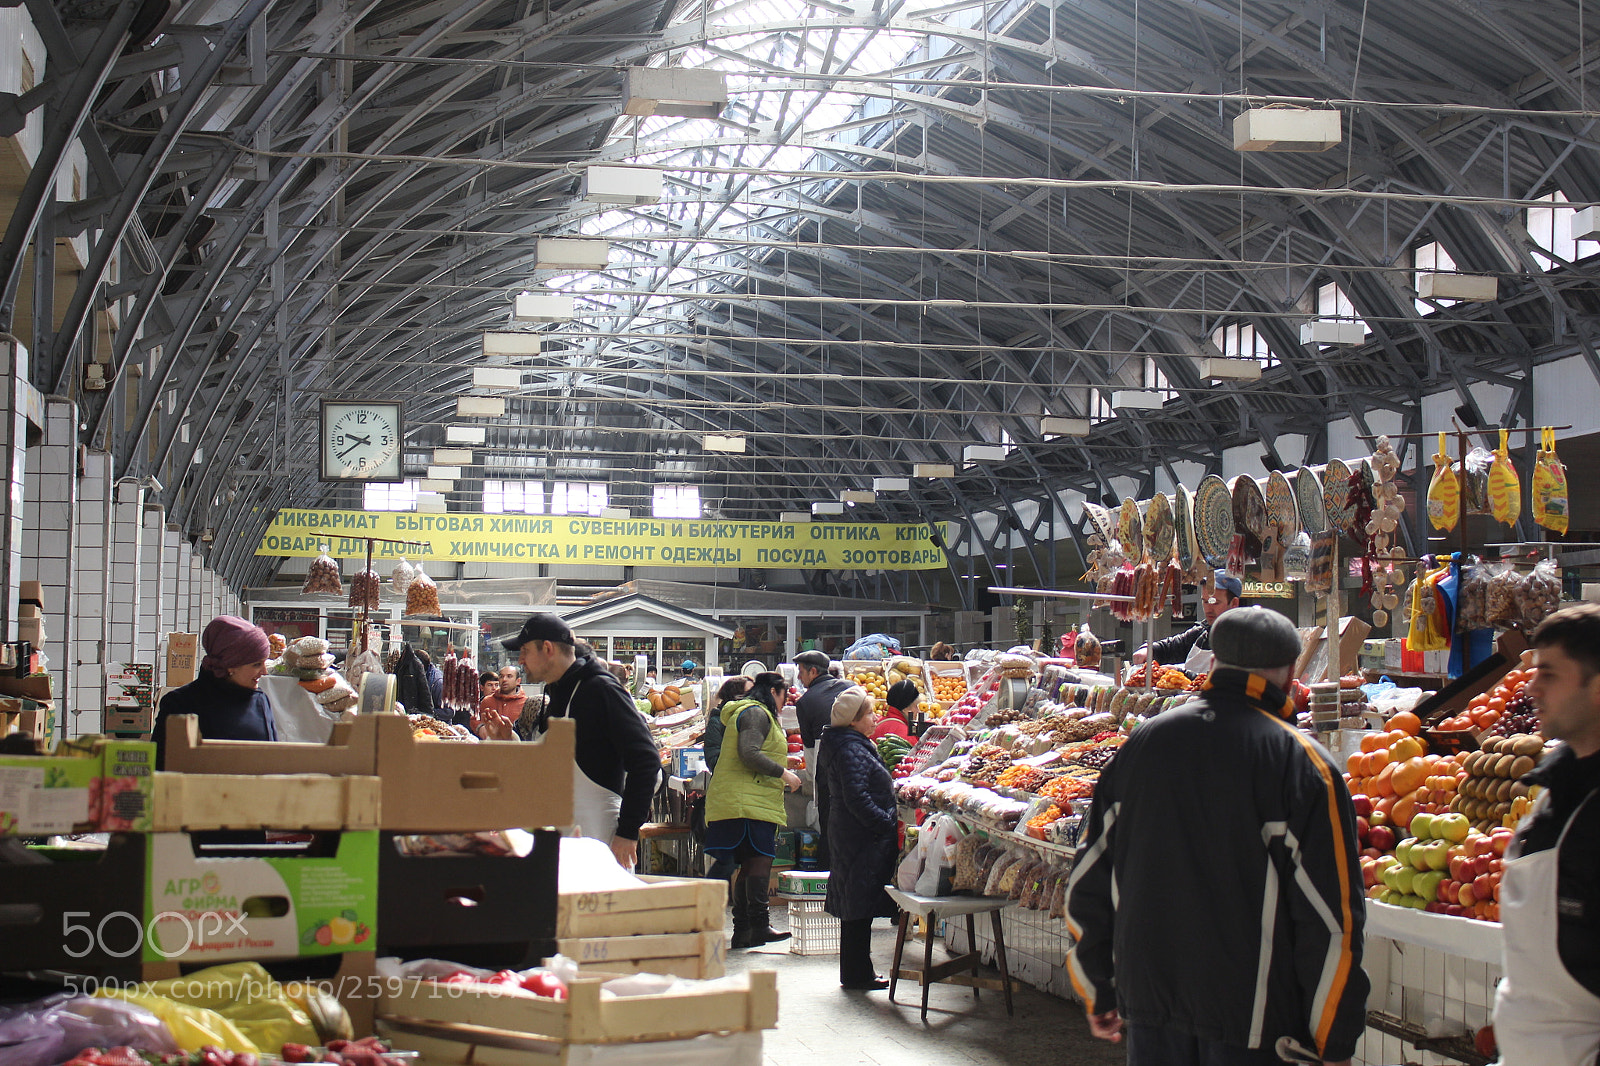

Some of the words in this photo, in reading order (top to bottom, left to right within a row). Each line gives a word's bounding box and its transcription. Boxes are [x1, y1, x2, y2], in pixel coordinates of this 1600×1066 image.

[357, 413, 367, 424] 12
[336, 435, 344, 446] 9
[380, 435, 388, 446] 3
[358, 457, 366, 467] 6
[275, 511, 380, 529] ТИКВАРИАТ
[395, 515, 484, 532] БЫТОВАЯ
[489, 518, 553, 534] ХИМИЯ
[569, 520, 665, 537] СУВЕНИРЫ
[671, 523, 683, 537] И
[689, 523, 795, 539] БИЖУТЕРИЯ
[810, 525, 881, 541] ОПТИКА
[895, 524, 947, 541] КЛЮИ
[380, 540, 434, 556] ДОМА
[449, 541, 560, 558] ХИМЧИСТКА
[565, 544, 578, 559] И
[583, 544, 656, 560] РЕМОНТ
[660, 546, 741, 564] ОДЕЖДЫ
[757, 548, 828, 566] ПОСУДА
[842, 549, 941, 564] ЗООТОВАРЫ
[1244, 582, 1283, 592] МЯСО
